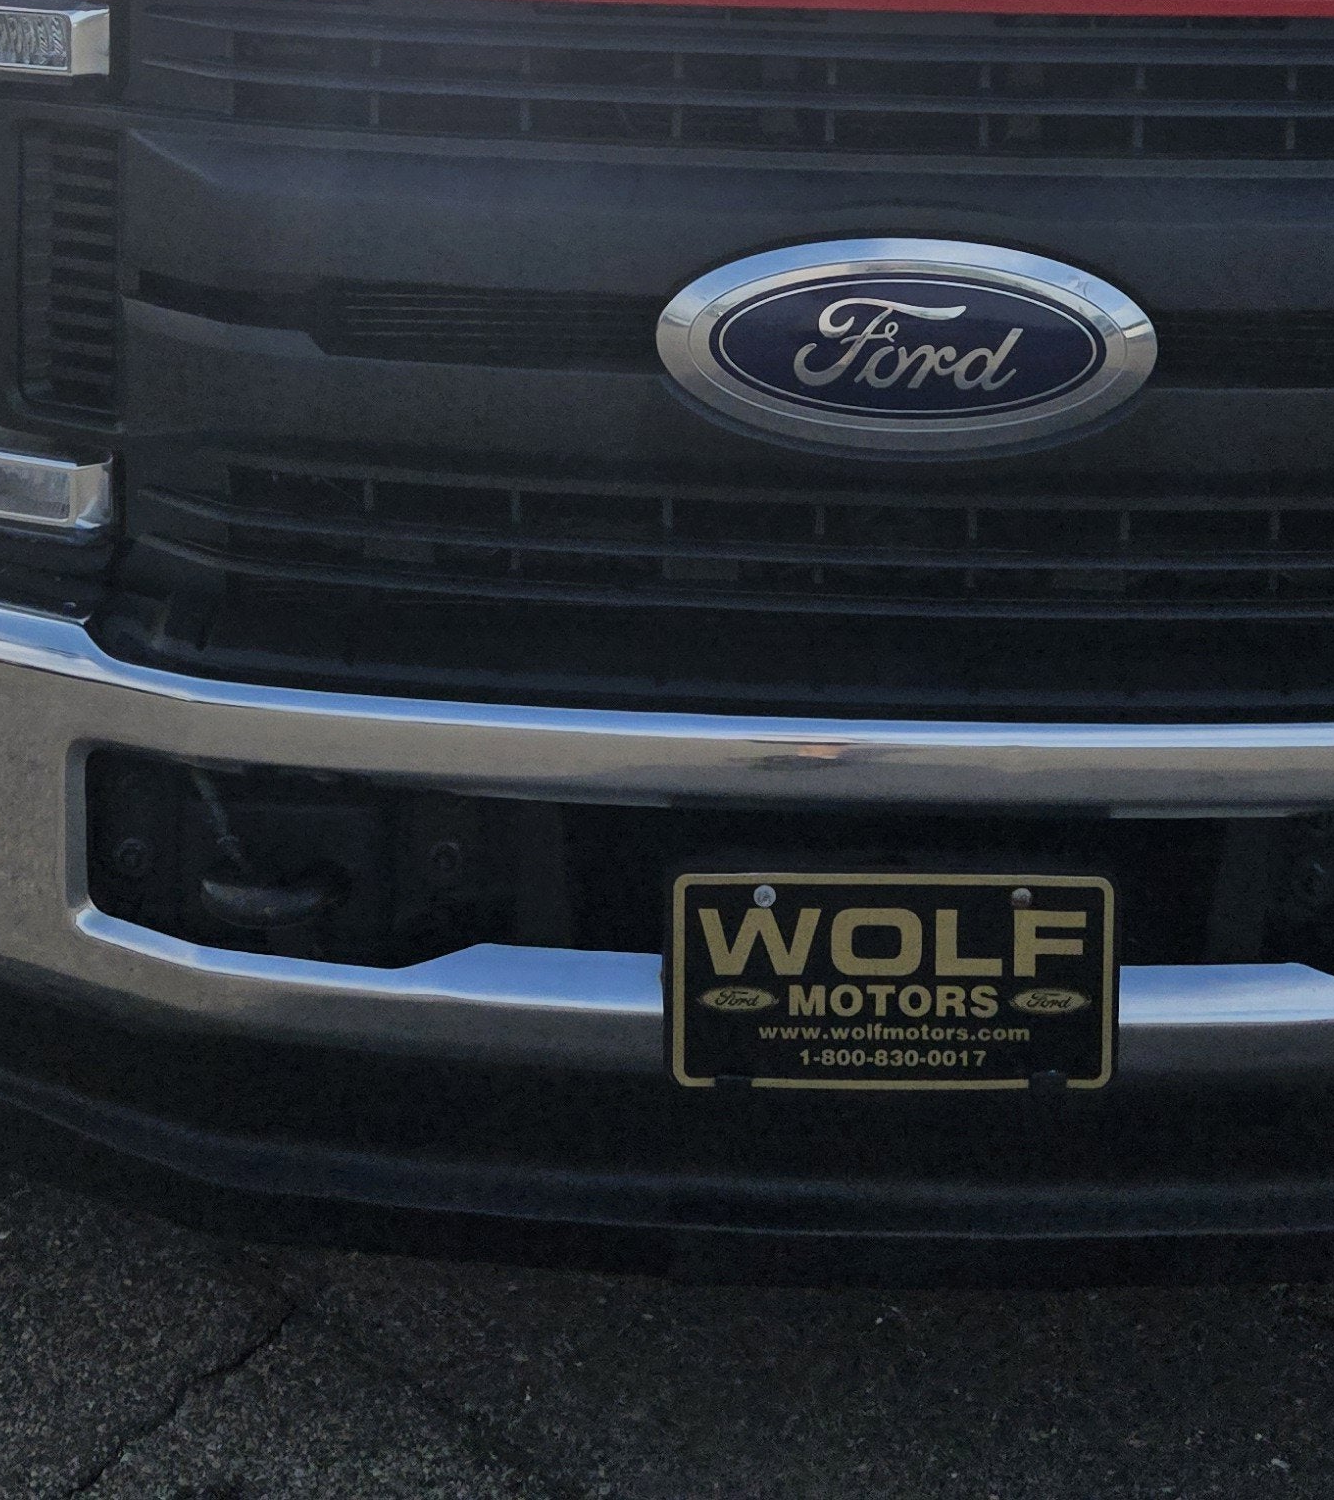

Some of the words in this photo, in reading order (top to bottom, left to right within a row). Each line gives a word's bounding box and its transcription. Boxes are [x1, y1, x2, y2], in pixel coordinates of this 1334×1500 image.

[793, 297, 1024, 391] Ford
[698, 908, 1087, 978] WOLF
[715, 989, 761, 1007] Ford
[788, 984, 999, 1018] MOTORS
[1026, 991, 1072, 1009] Ford
[758, 1023, 1031, 1042] www.wolfmotors.com
[799, 1049, 987, 1067] 1-800-830-0017
